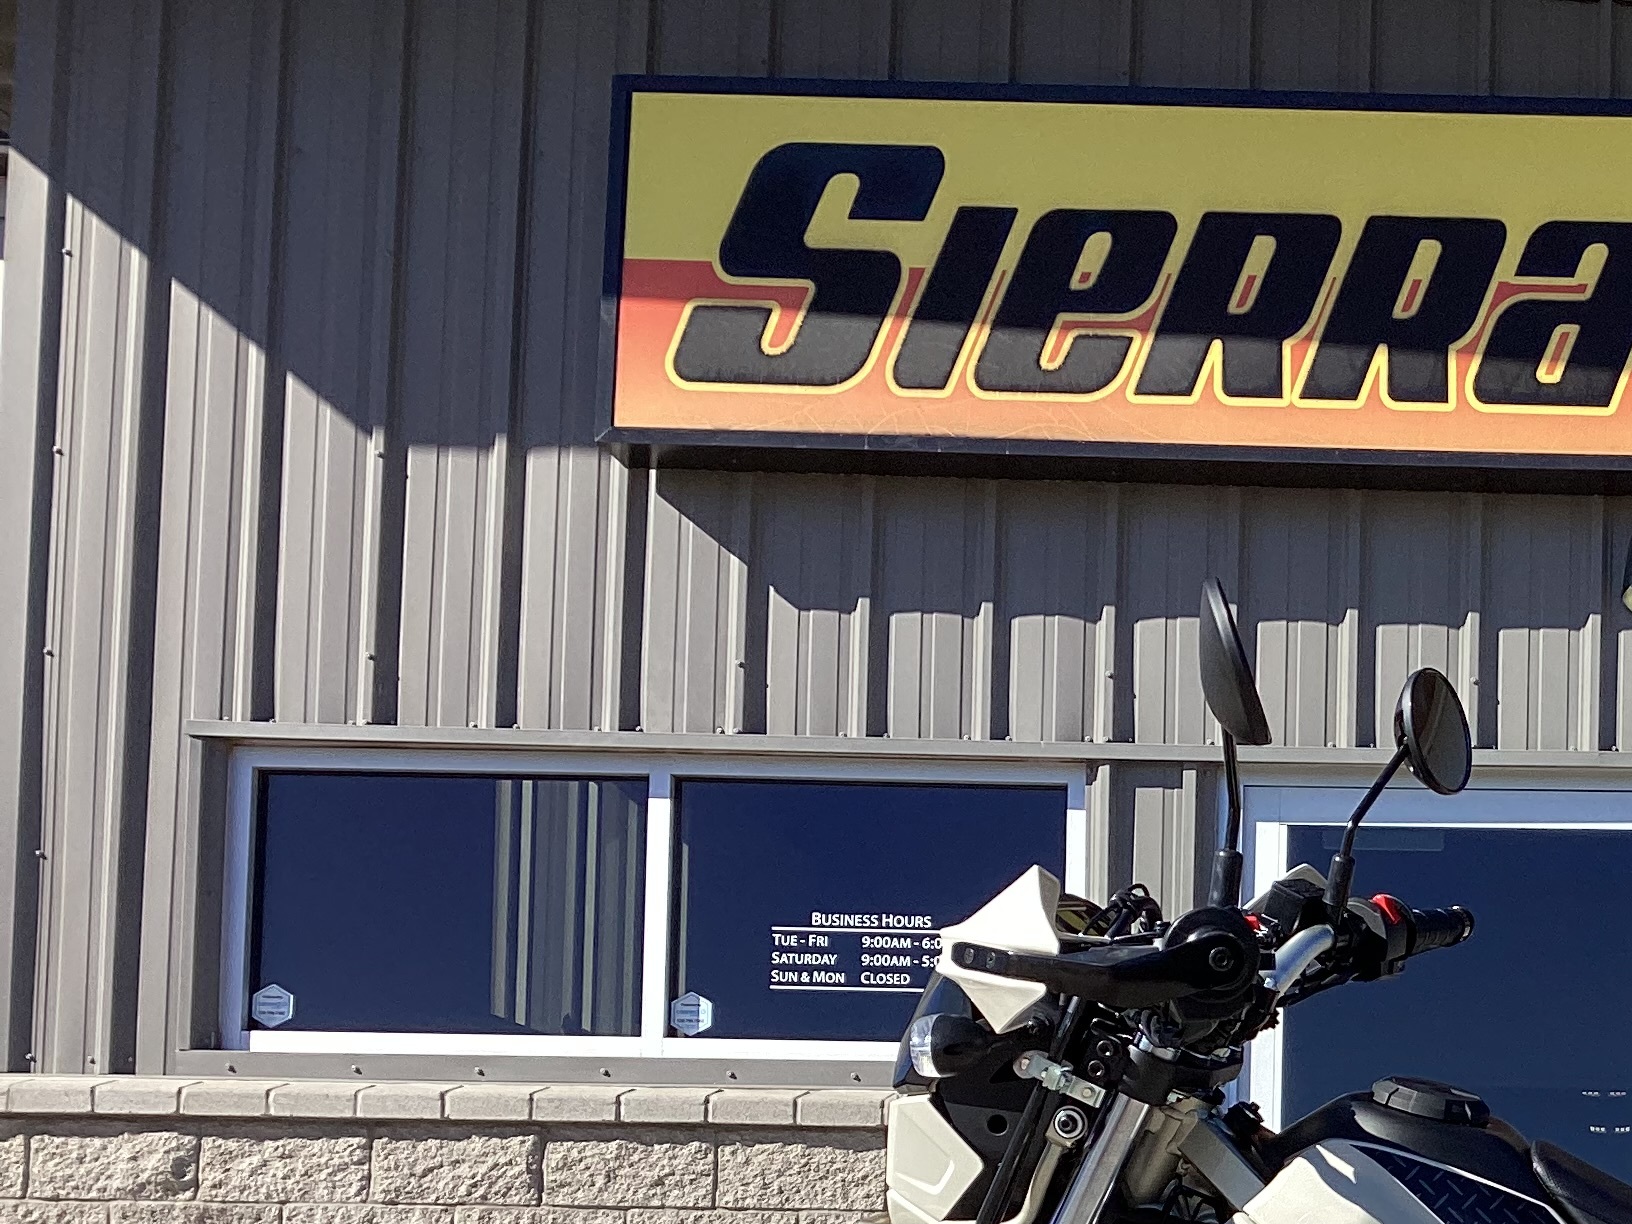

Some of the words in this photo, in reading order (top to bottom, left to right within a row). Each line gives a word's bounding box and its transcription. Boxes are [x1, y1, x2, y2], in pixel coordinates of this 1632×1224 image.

[811, 911, 879, 927] BUSINESS
[881, 914, 932, 928] HOURS
[772, 933, 798, 947] TUE
[808, 934, 828, 947] FRI
[861, 936, 911, 949] 9:00AM
[921, 937, 941, 950] 6:0
[771, 952, 838, 965] SATURDAY
[861, 954, 911, 966] 9:00AM
[770, 970, 798, 983] SUN
[800, 971, 811, 983] &
[812, 971, 845, 983] MON
[860, 972, 911, 985] CLOSED
